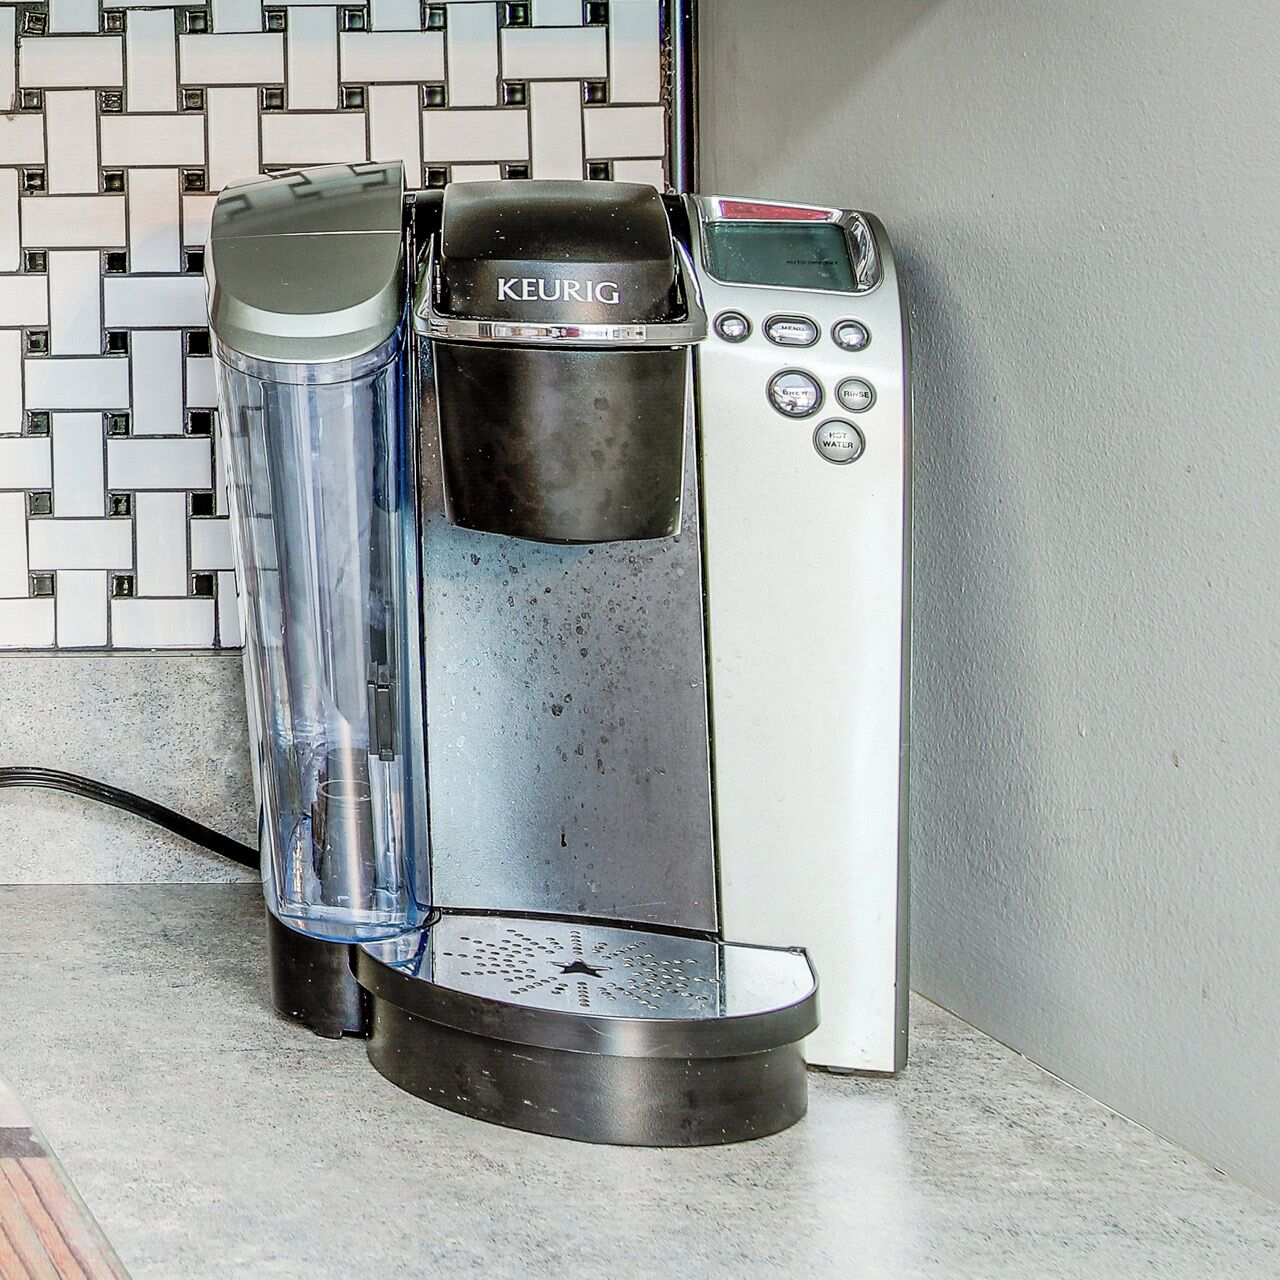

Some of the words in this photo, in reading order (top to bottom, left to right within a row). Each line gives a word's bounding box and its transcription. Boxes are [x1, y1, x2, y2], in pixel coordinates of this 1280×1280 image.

[496, 277, 621, 305] KEURIG
[780, 324, 805, 332] MENU
[782, 388, 809, 397] BREW
[843, 389, 870, 399] RINSE
[828, 431, 848, 440] HOT
[822, 440, 854, 450] WATER
